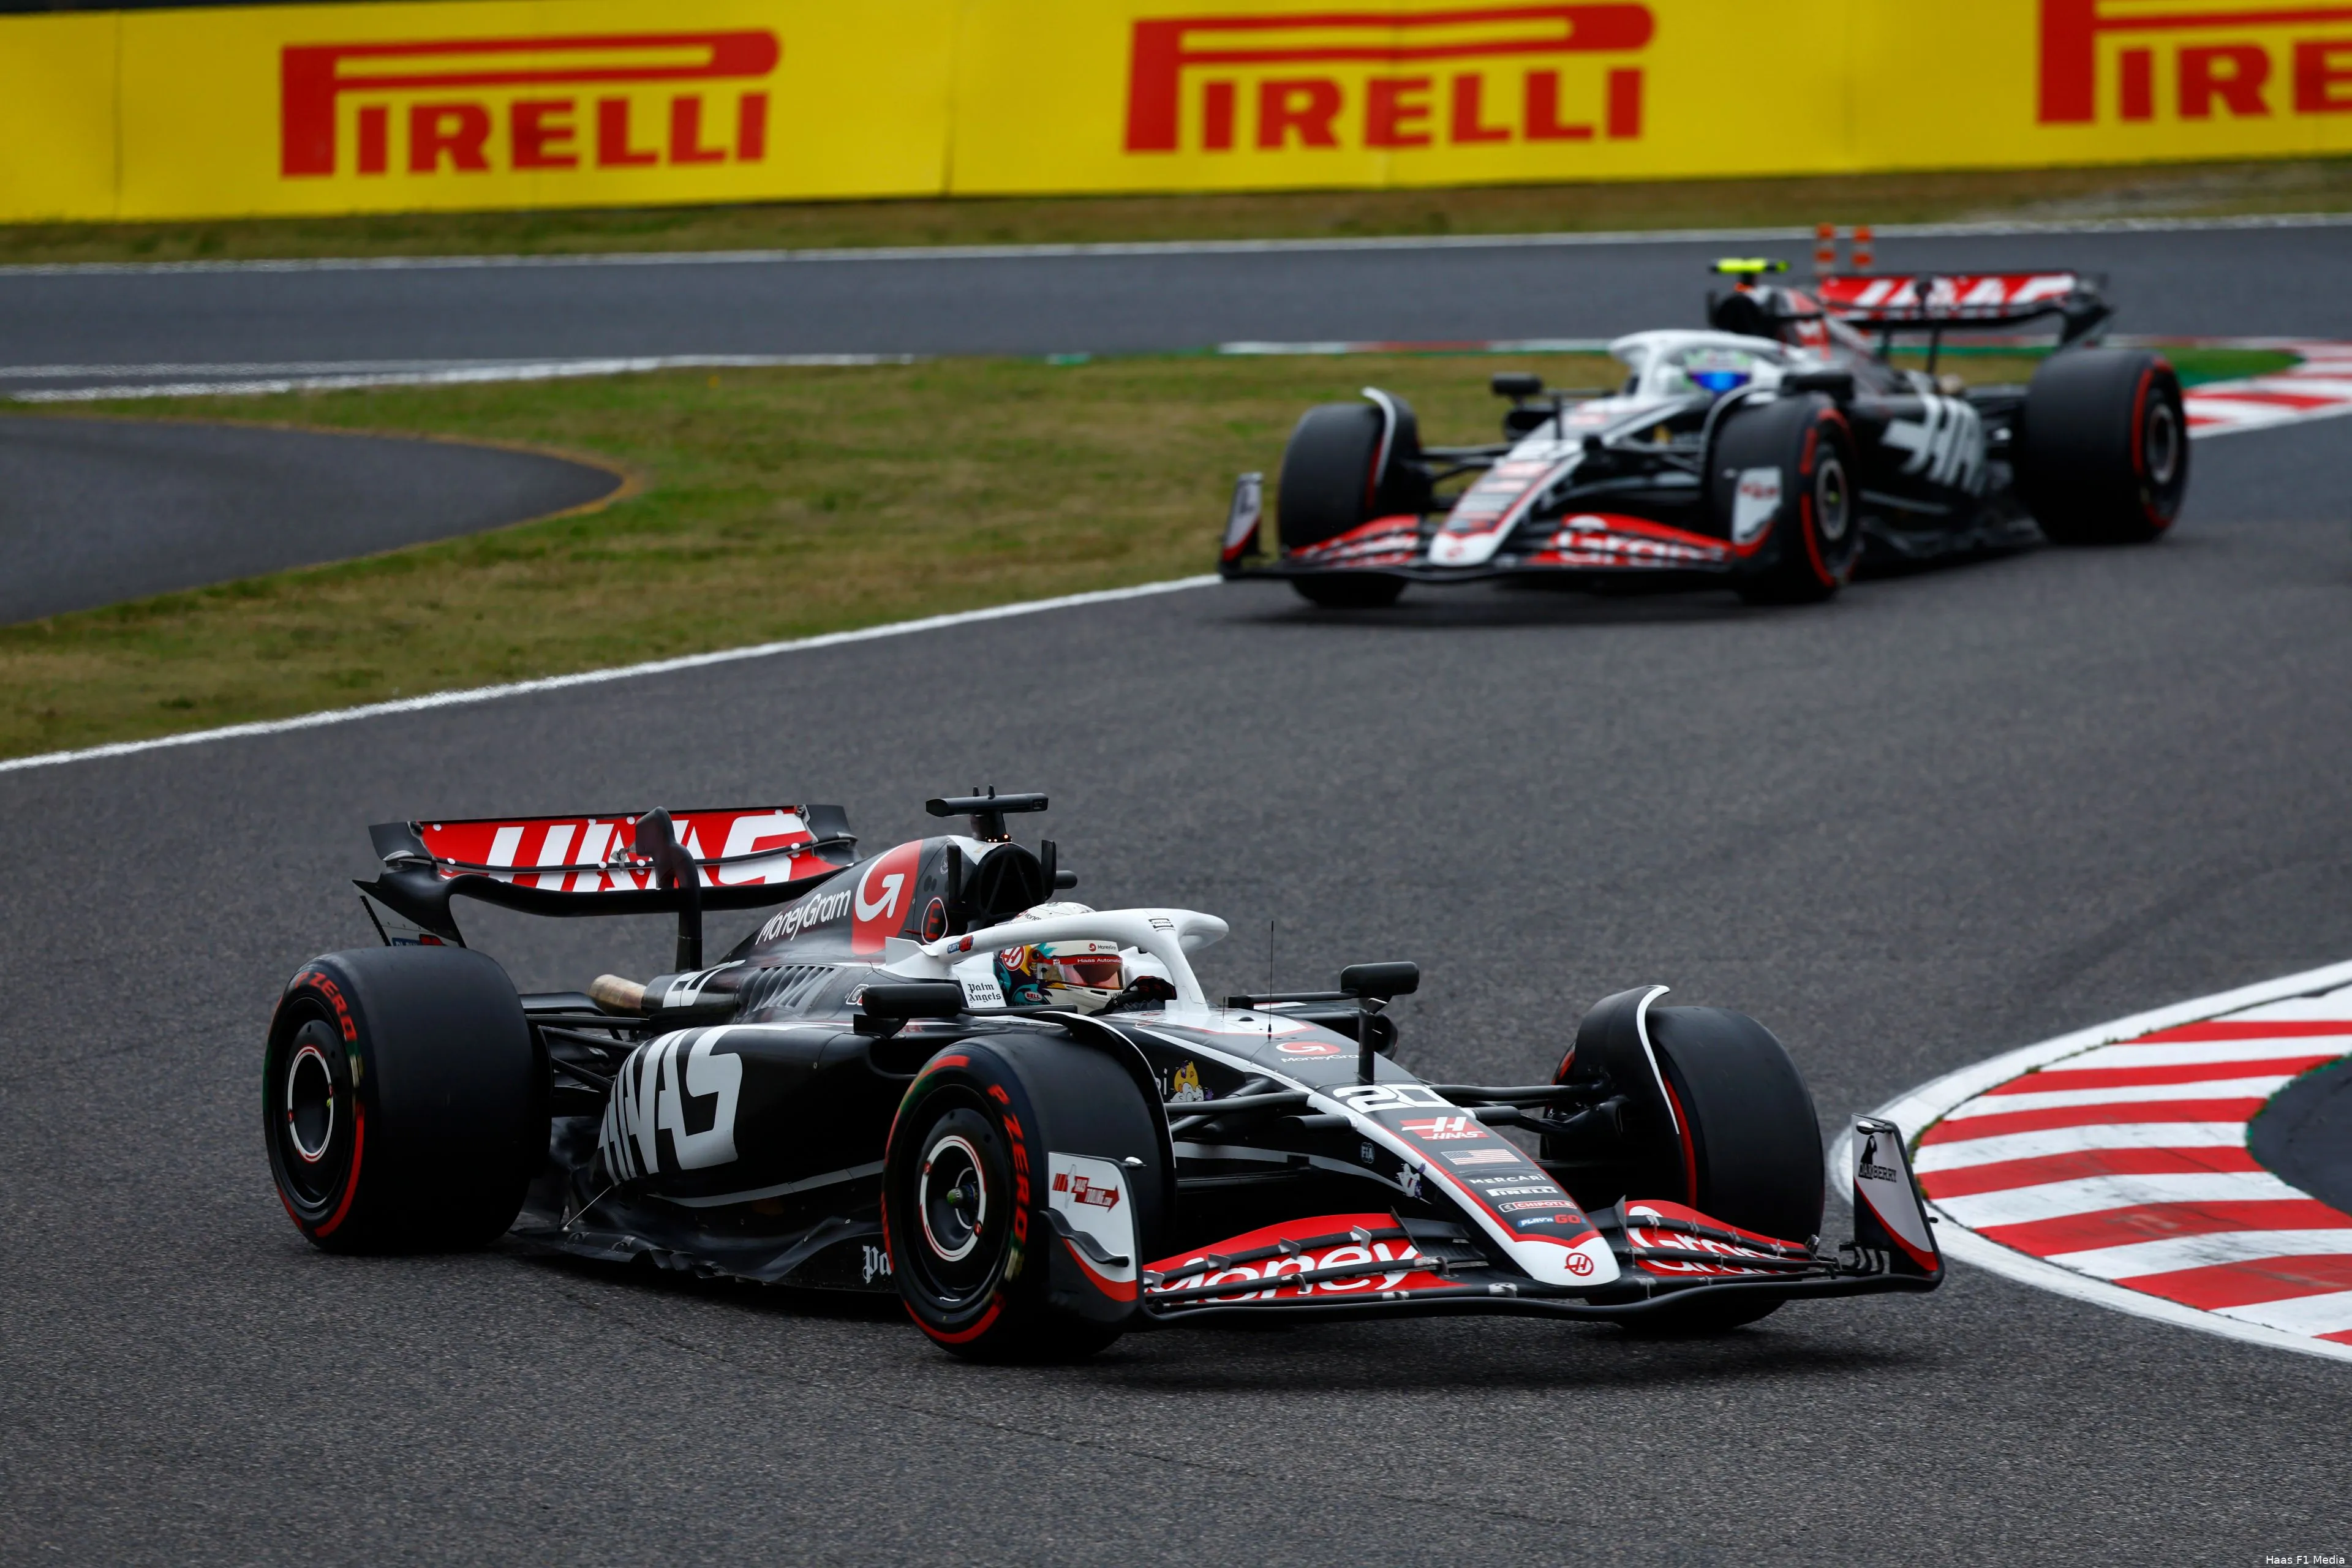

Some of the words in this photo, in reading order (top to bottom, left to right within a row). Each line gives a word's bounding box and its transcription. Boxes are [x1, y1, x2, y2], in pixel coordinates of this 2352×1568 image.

[1123, 2, 1656, 154] PIRELLI
[279, 28, 782, 179] PIRELLI
[755, 889, 851, 946] MoneyGram
[968, 982, 995, 993] Palm
[968, 992, 1001, 1003] Angels
[309, 971, 358, 1042] ZERO
[1333, 1084, 1457, 1114] 20
[1422, 1131, 1483, 1140] HAAS
[986, 1084, 1011, 1106] P
[1001, 1112, 1031, 1246] ZERO
[1485, 1186, 1559, 1197] PIRELLI
[1554, 1214, 1581, 1224] GO
